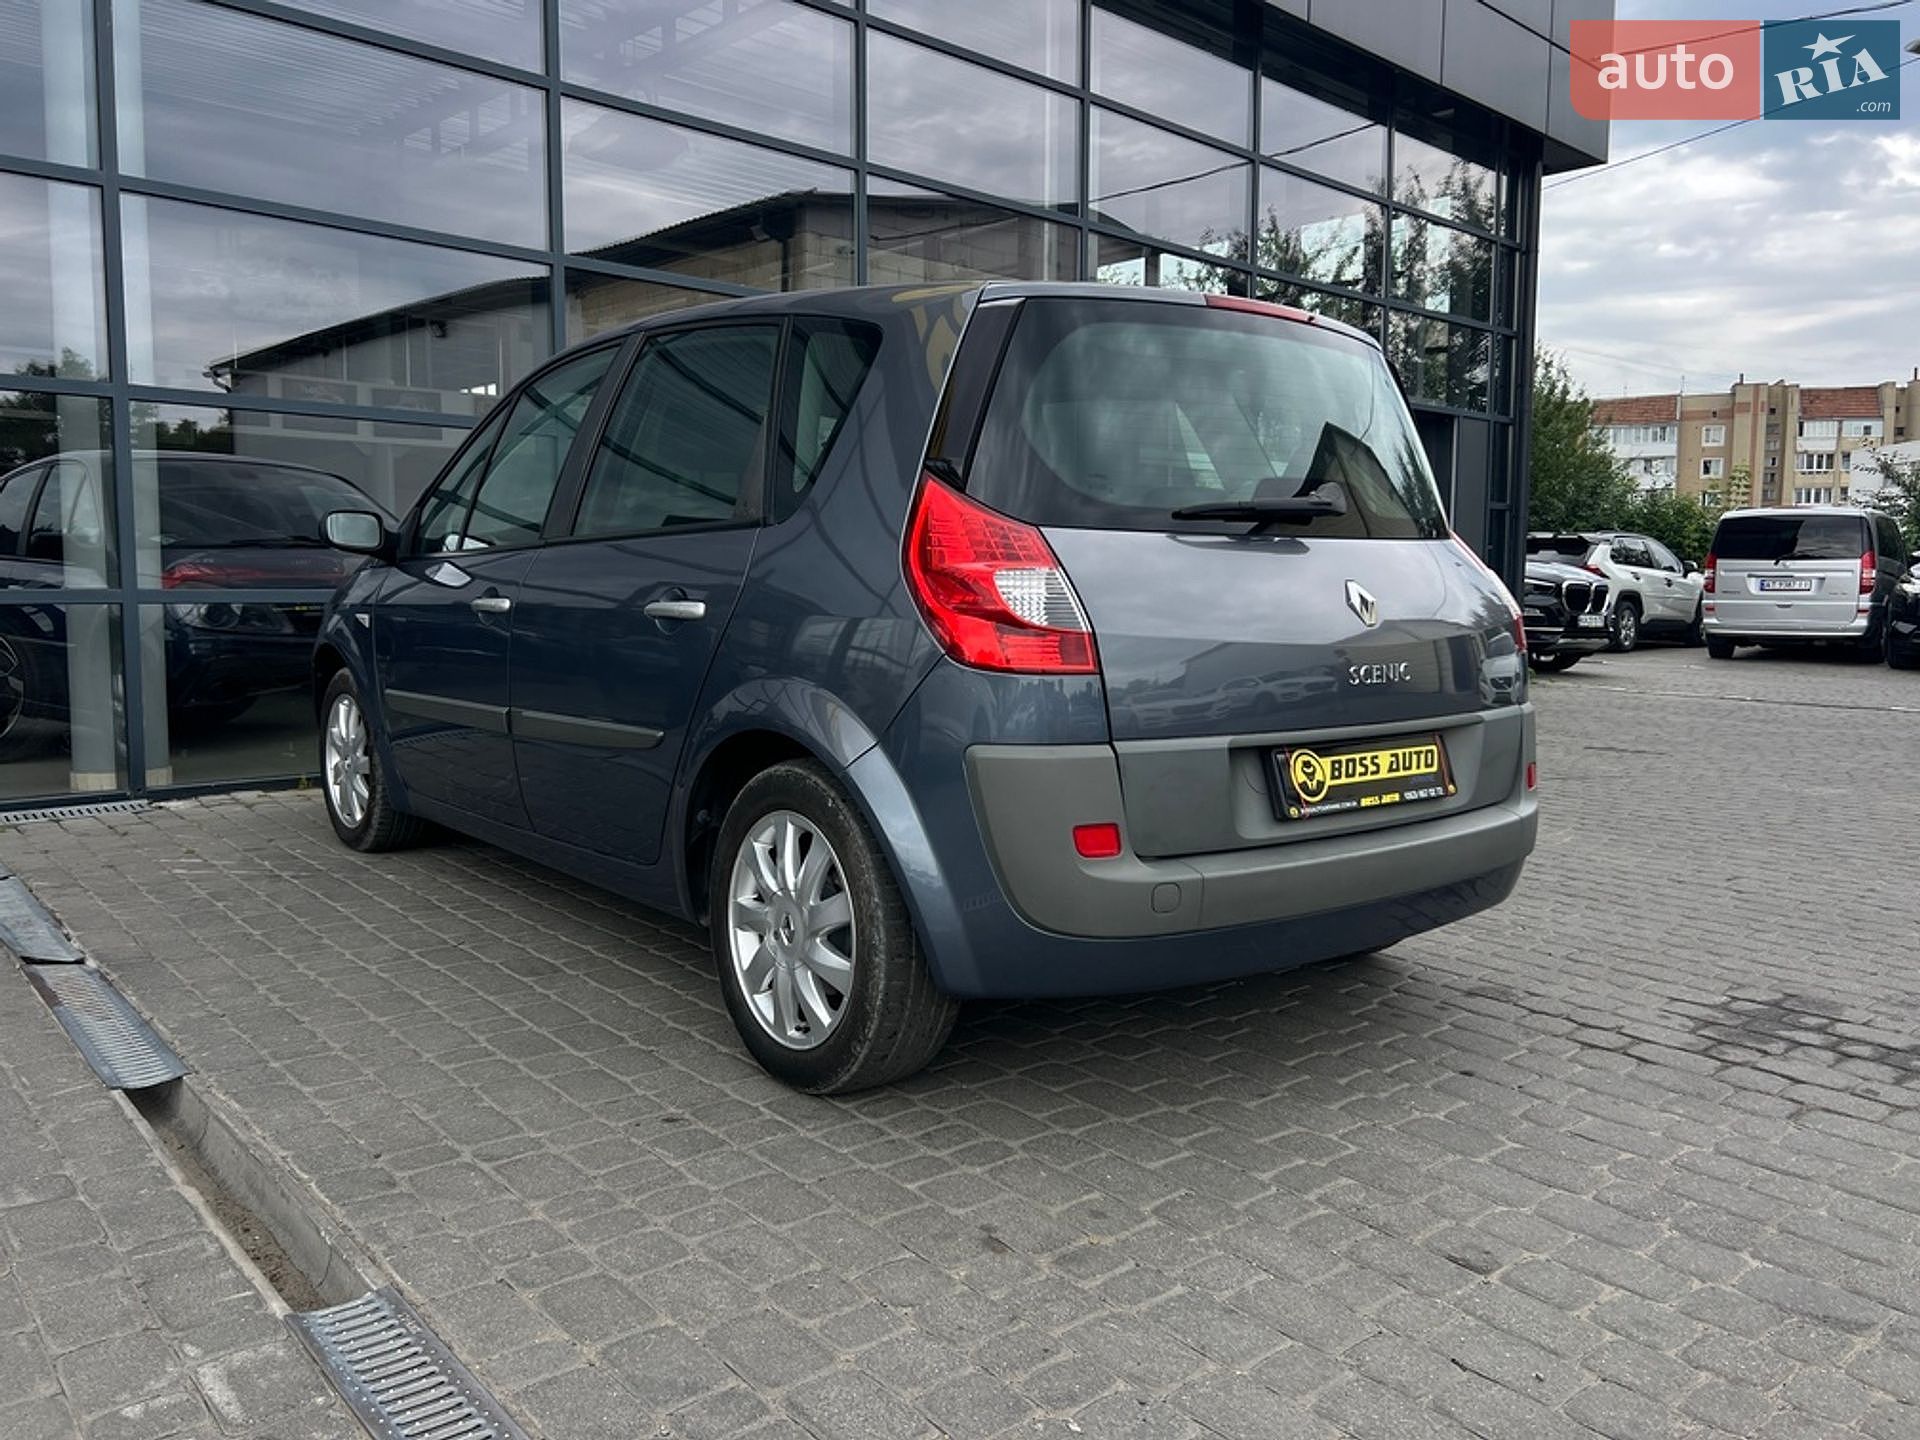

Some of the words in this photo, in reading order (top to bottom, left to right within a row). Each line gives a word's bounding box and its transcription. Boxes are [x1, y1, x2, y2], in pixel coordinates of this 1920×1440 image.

[1348, 661, 1412, 685] SCENIC
[1329, 752, 1381, 781] BOSS
[1387, 748, 1436, 774] AUTO
